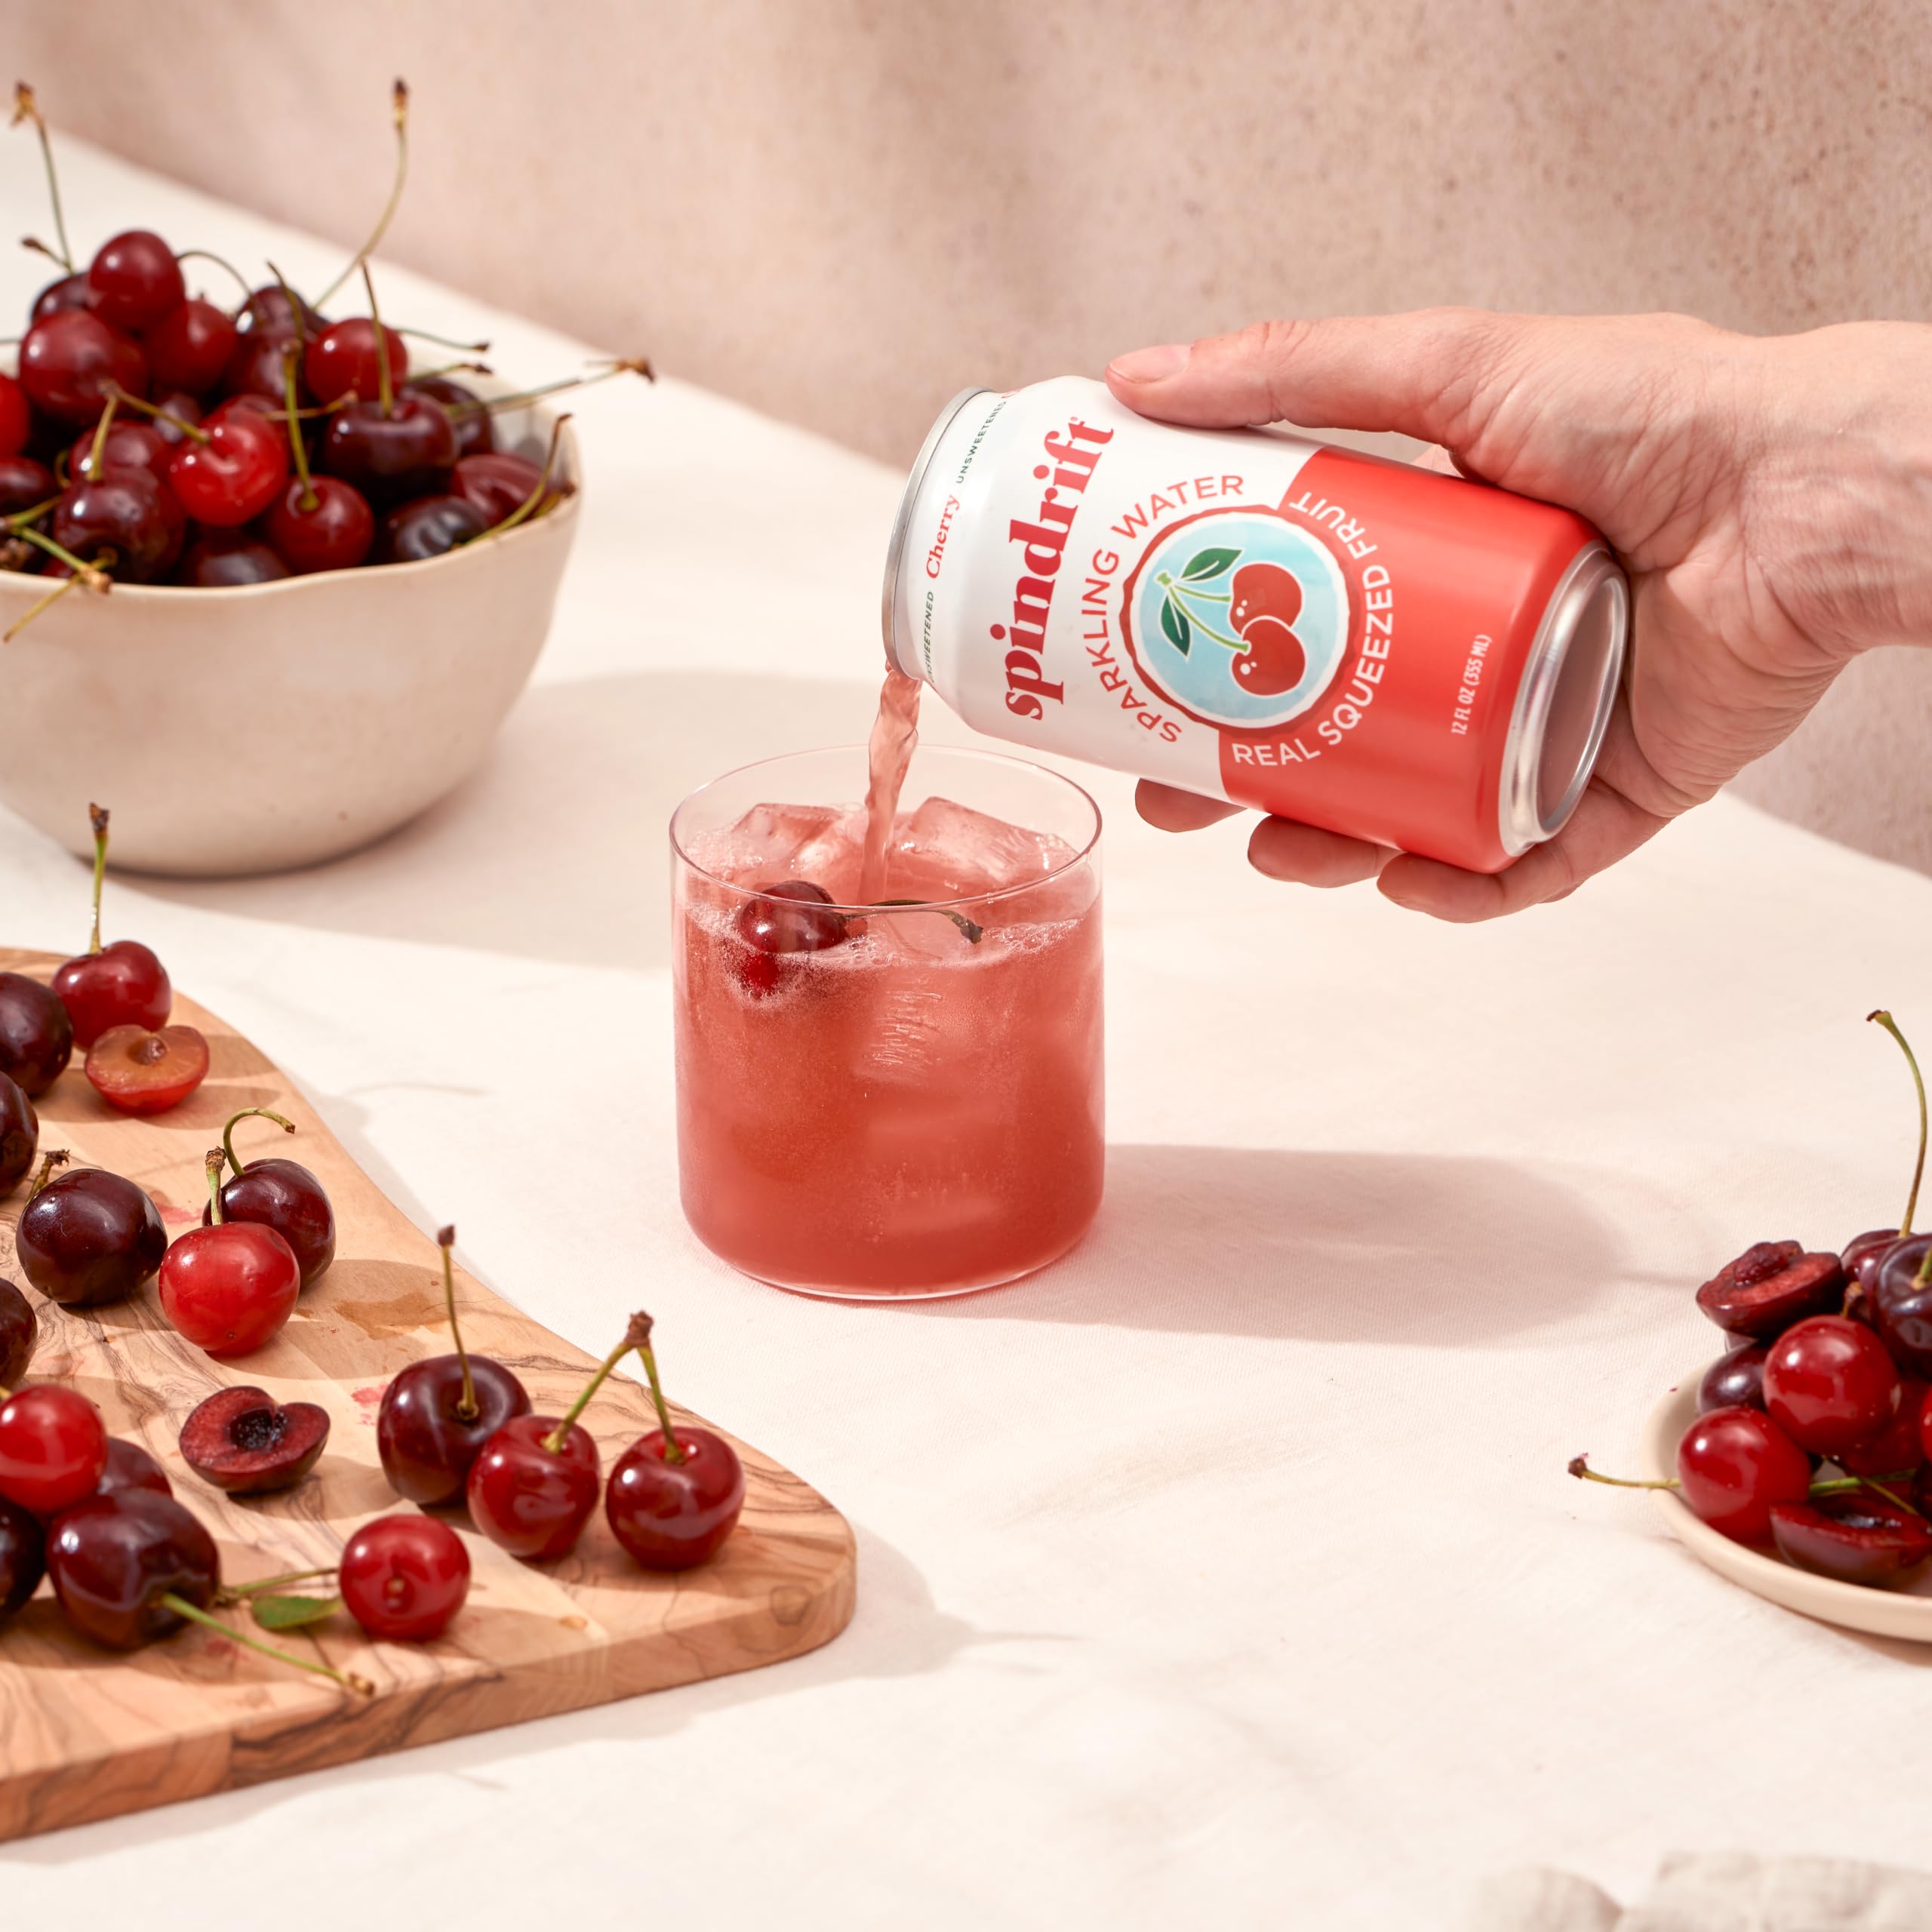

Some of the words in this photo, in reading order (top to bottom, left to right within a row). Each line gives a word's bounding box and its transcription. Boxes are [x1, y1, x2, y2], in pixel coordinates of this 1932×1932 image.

[955, 401, 1007, 484] UNSWEETENED
[926, 494, 961, 579] Cherry
[1111, 475, 1244, 540] WATER
[1289, 492, 1378, 560] FRUIT
[990, 420, 1114, 720] spindrift
[1081, 549, 1182, 744] SPARKLING
[1318, 565, 1393, 746] SQUEEZED
[1463, 657, 1484, 686] (355
[1470, 634, 1493, 657] ML)
[1451, 721, 1468, 735] 12
[1454, 707, 1471, 721] FL
[1457, 687, 1476, 705] OZ
[1232, 738, 1321, 767] REAL
